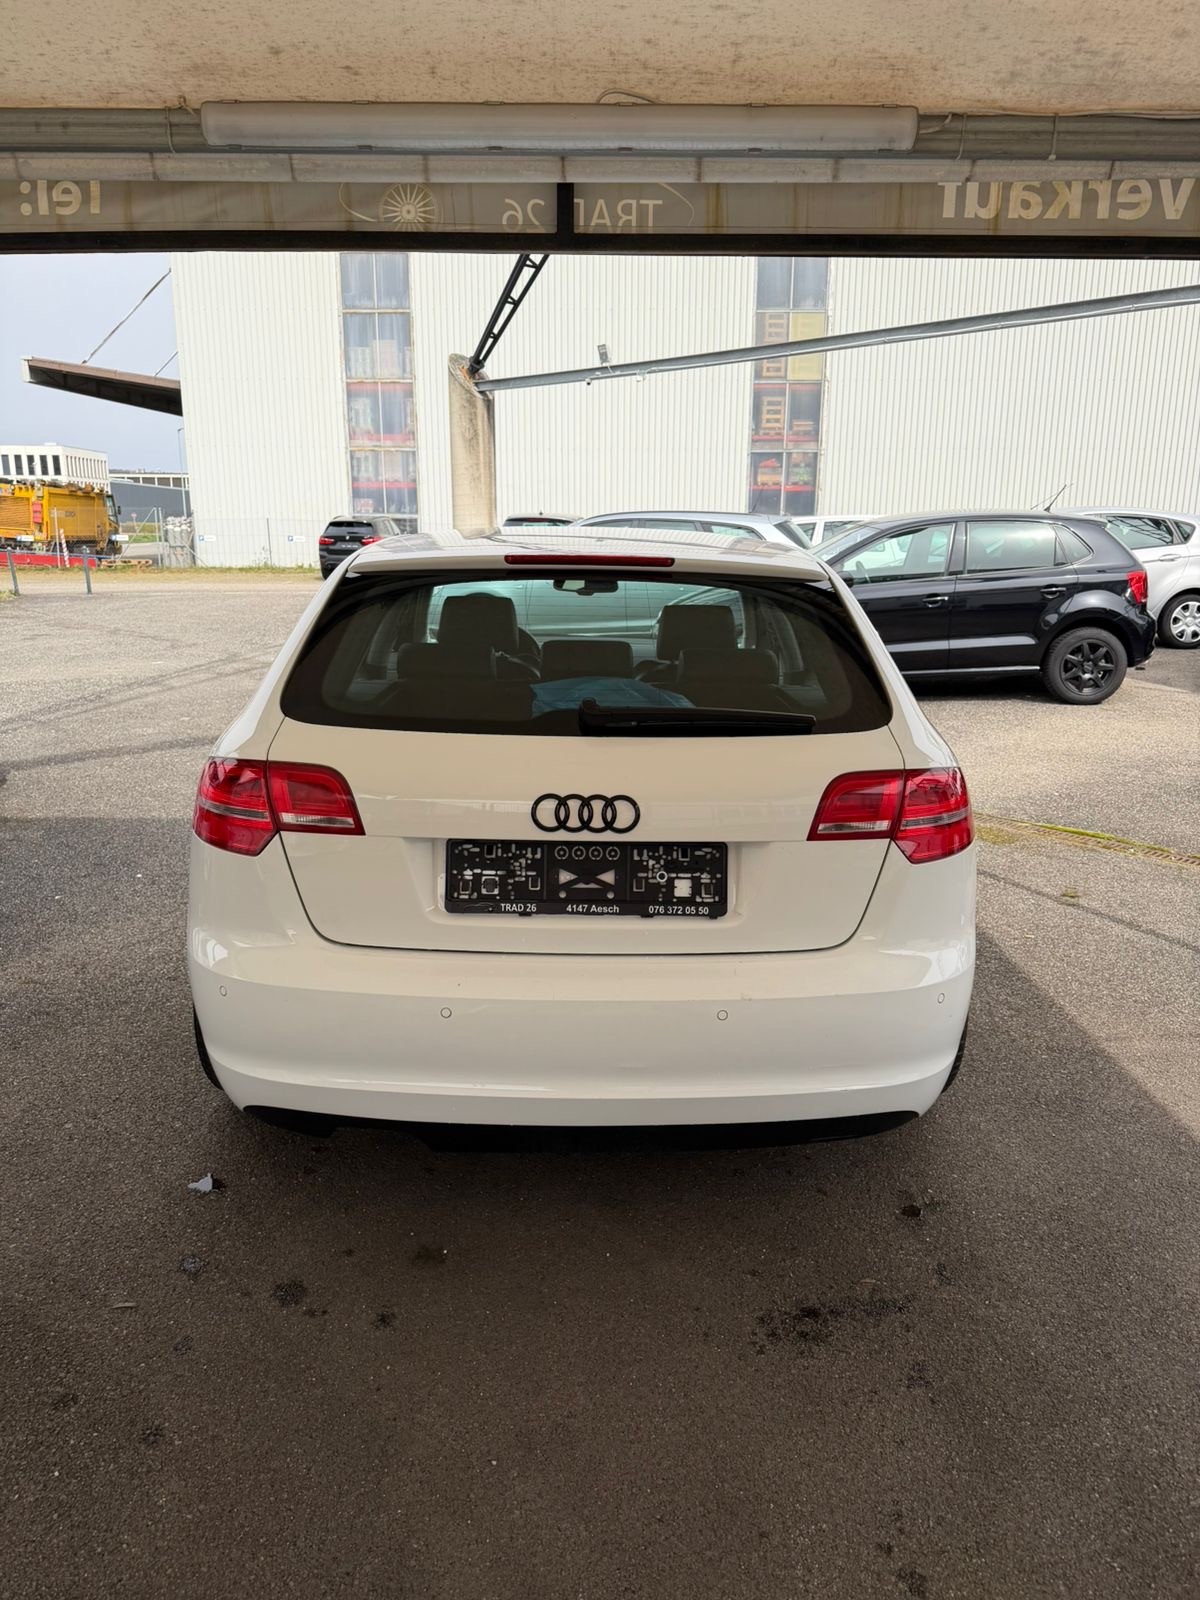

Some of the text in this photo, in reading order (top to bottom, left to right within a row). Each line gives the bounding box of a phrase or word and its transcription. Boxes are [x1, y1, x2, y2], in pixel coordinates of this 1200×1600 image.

[500, 903, 537, 912] TRAD 26
[566, 904, 620, 914] 4147 Aesch
[648, 905, 709, 915] 076 372 05 50
